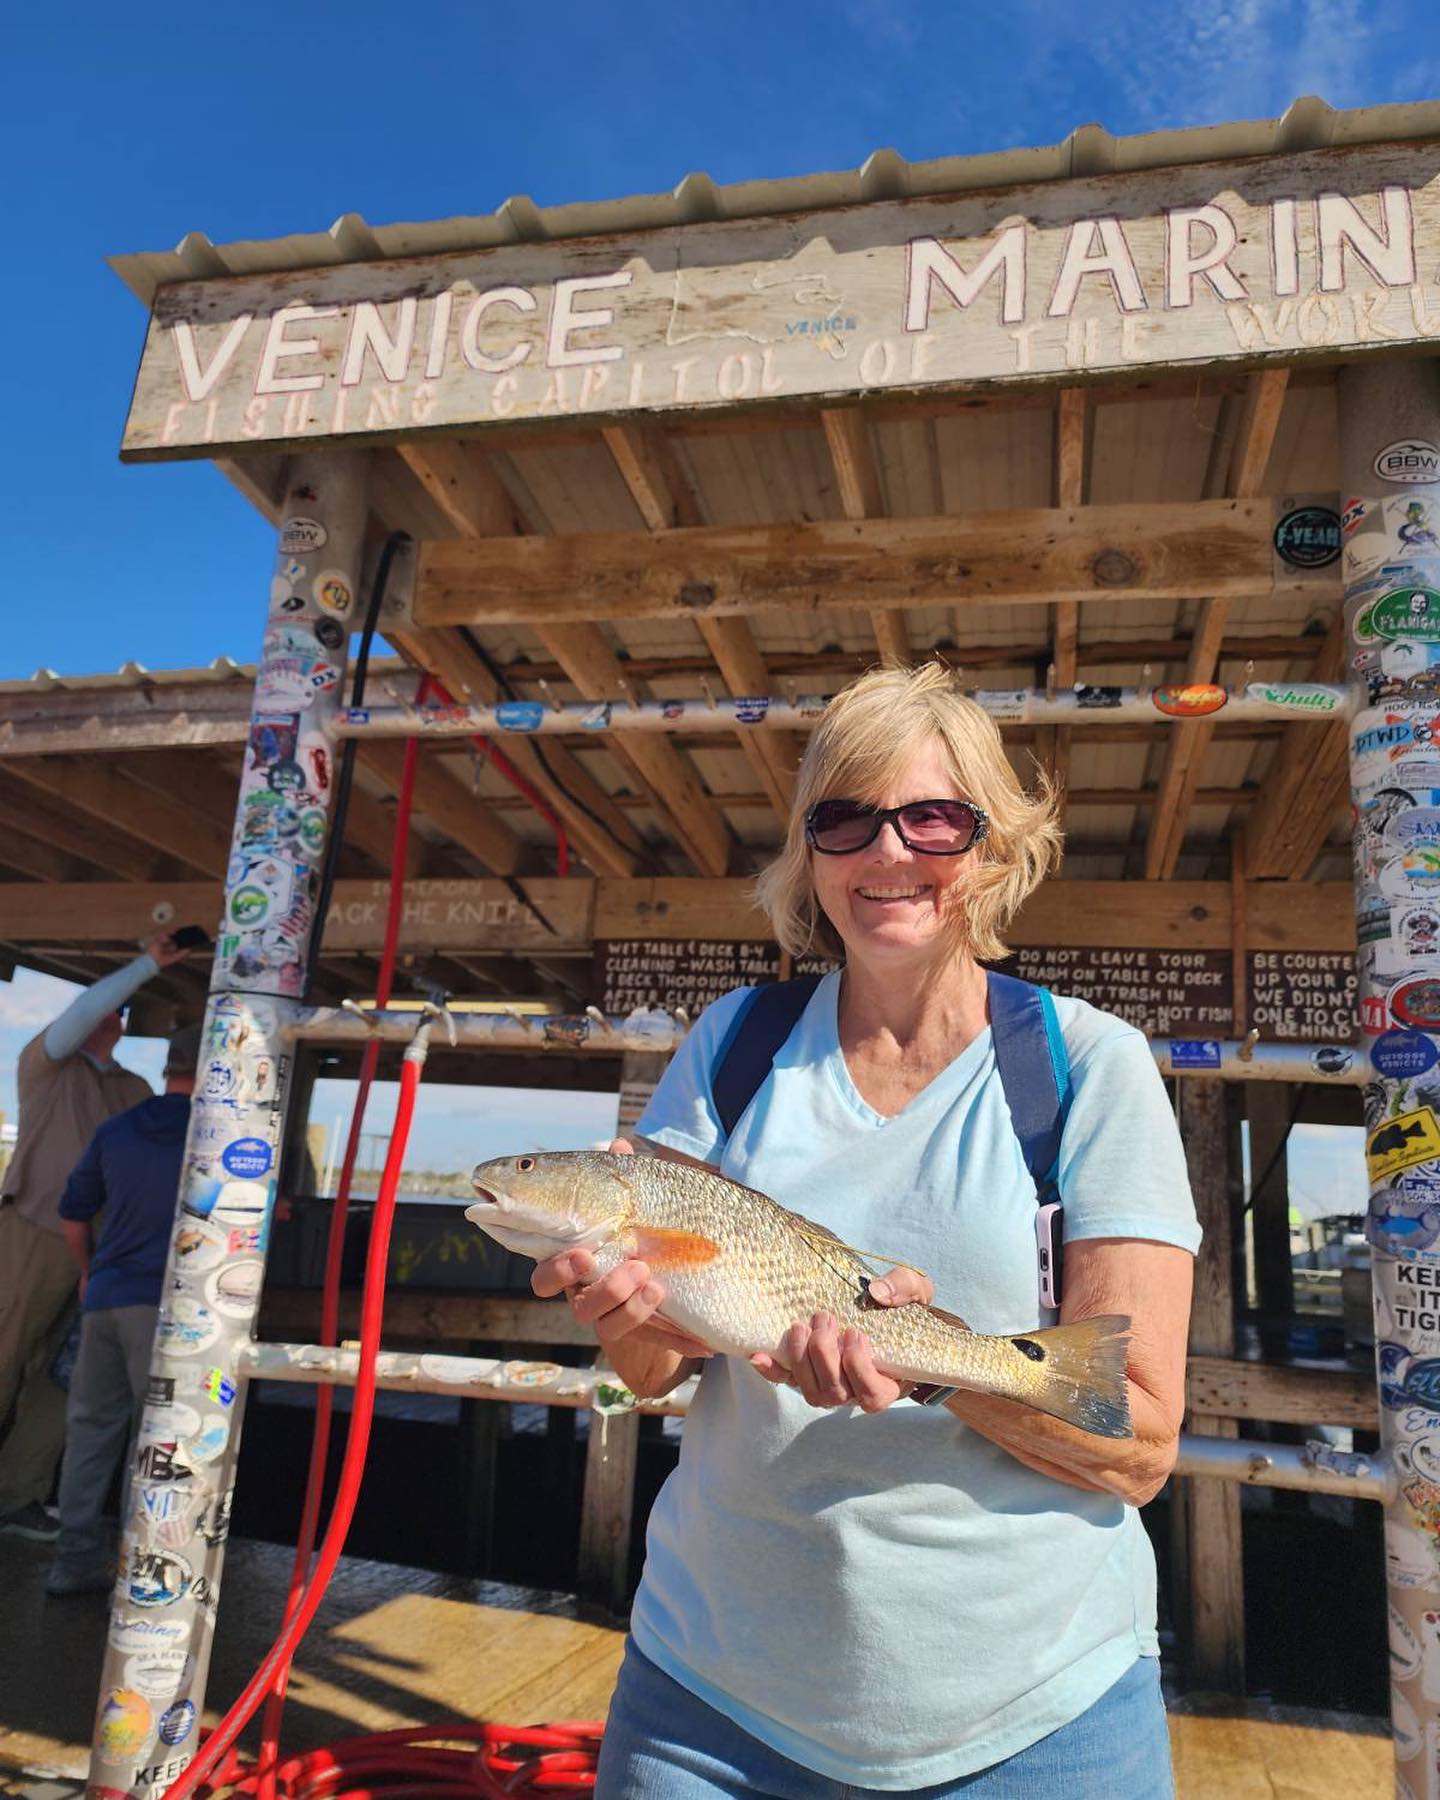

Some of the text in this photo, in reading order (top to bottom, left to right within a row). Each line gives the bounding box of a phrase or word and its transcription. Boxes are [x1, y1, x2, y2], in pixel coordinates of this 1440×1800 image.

[172, 184, 1440, 402] VENICE MARIN
[785, 316, 858, 336] VENICE
[159, 286, 1440, 446] FISHING CAPITOL OF THE WORL
[326, 902, 378, 926] ACK
[643, 942, 684, 957] TABLE
[699, 943, 735, 958] DECK
[1019, 950, 1207, 968] DO NOT LEAVE YOUR
[605, 957, 676, 972] CLEANING
[1253, 953, 1353, 971] BE COURTE
[1016, 965, 1224, 986] TRASH ON TABLE OR DECK
[1255, 973, 1281, 987] UP
[1286, 973, 1336, 987] YOUR
[1107, 985, 1161, 1002] TRASH
[1167, 988, 1186, 1003] IN
[1253, 988, 1285, 1006] WE
[1253, 1008, 1296, 1026] ONE
[1303, 1008, 1328, 1026] TO
[1332, 1008, 1362, 1028] CL
[1275, 1023, 1352, 1039] BEHIND
[1395, 1306, 1440, 1331] TIG
